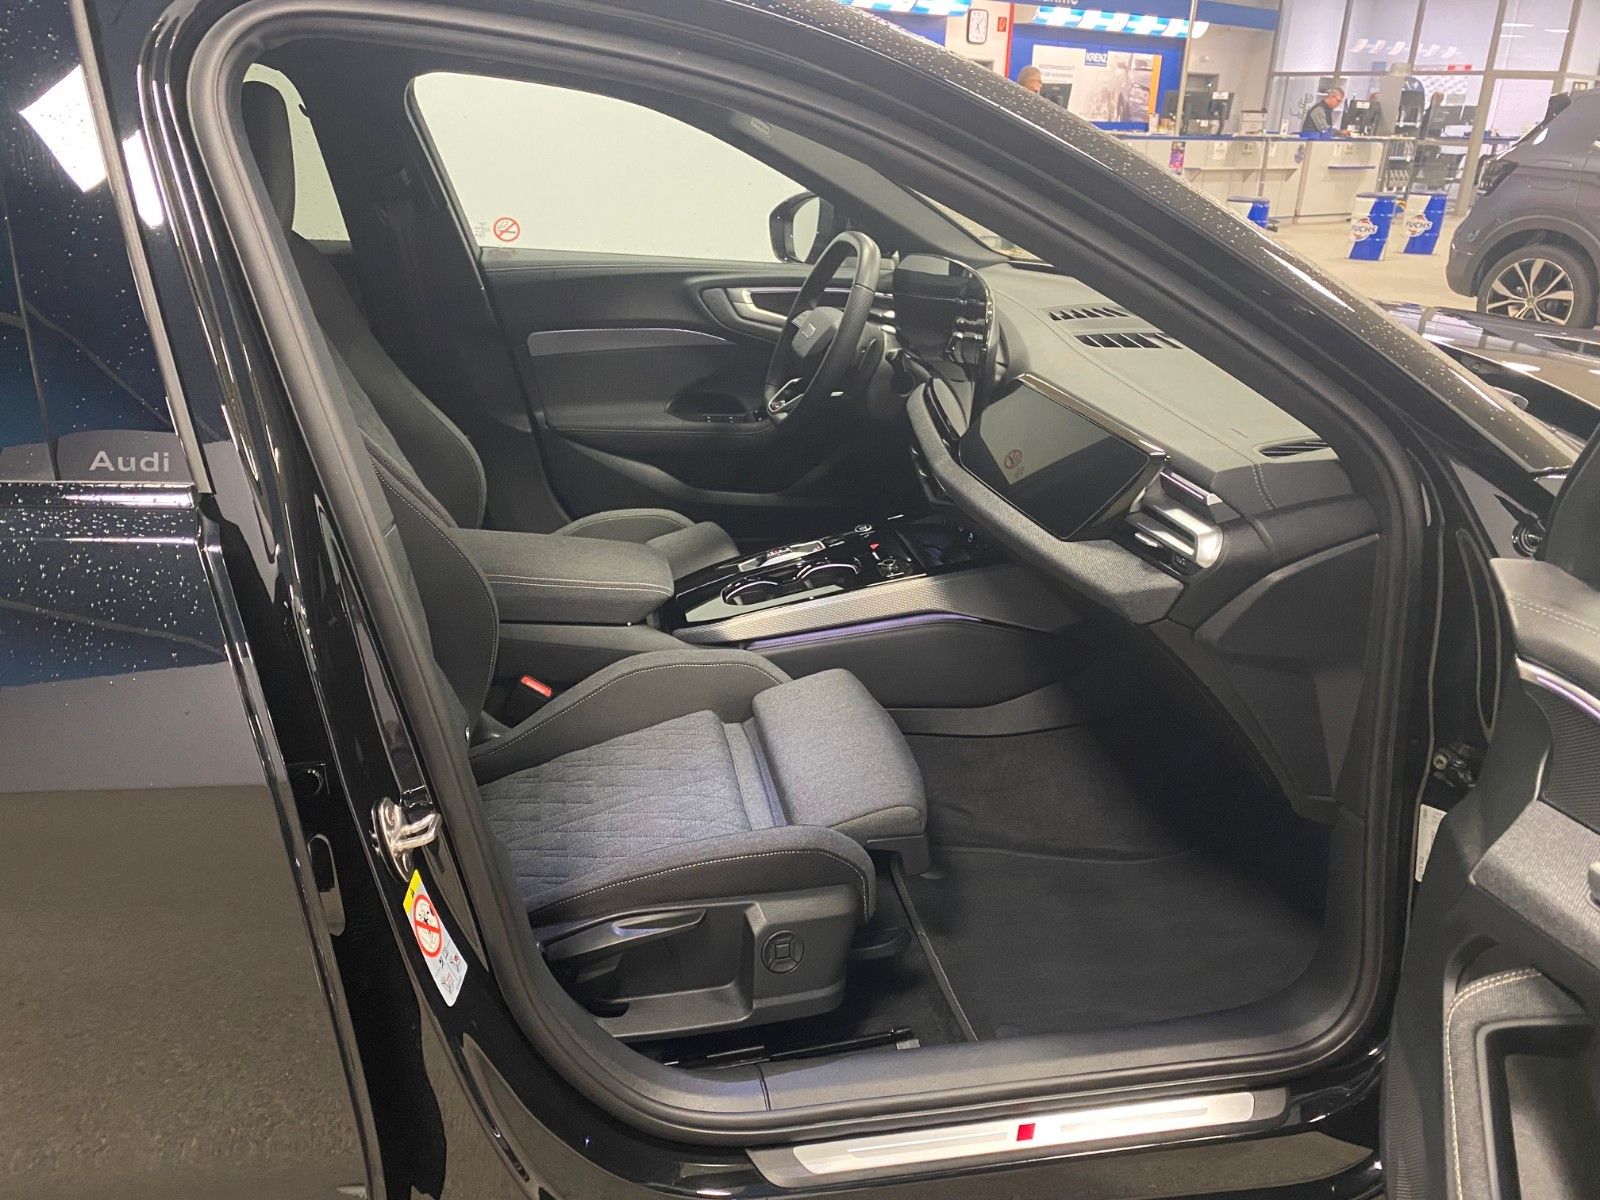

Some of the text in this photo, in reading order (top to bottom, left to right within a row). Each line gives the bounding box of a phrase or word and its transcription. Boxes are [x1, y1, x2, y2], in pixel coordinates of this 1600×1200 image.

[1352, 224, 1376, 233] FUCHS
[1406, 221, 1431, 230] FUCHS
[89, 450, 169, 472] Audi
